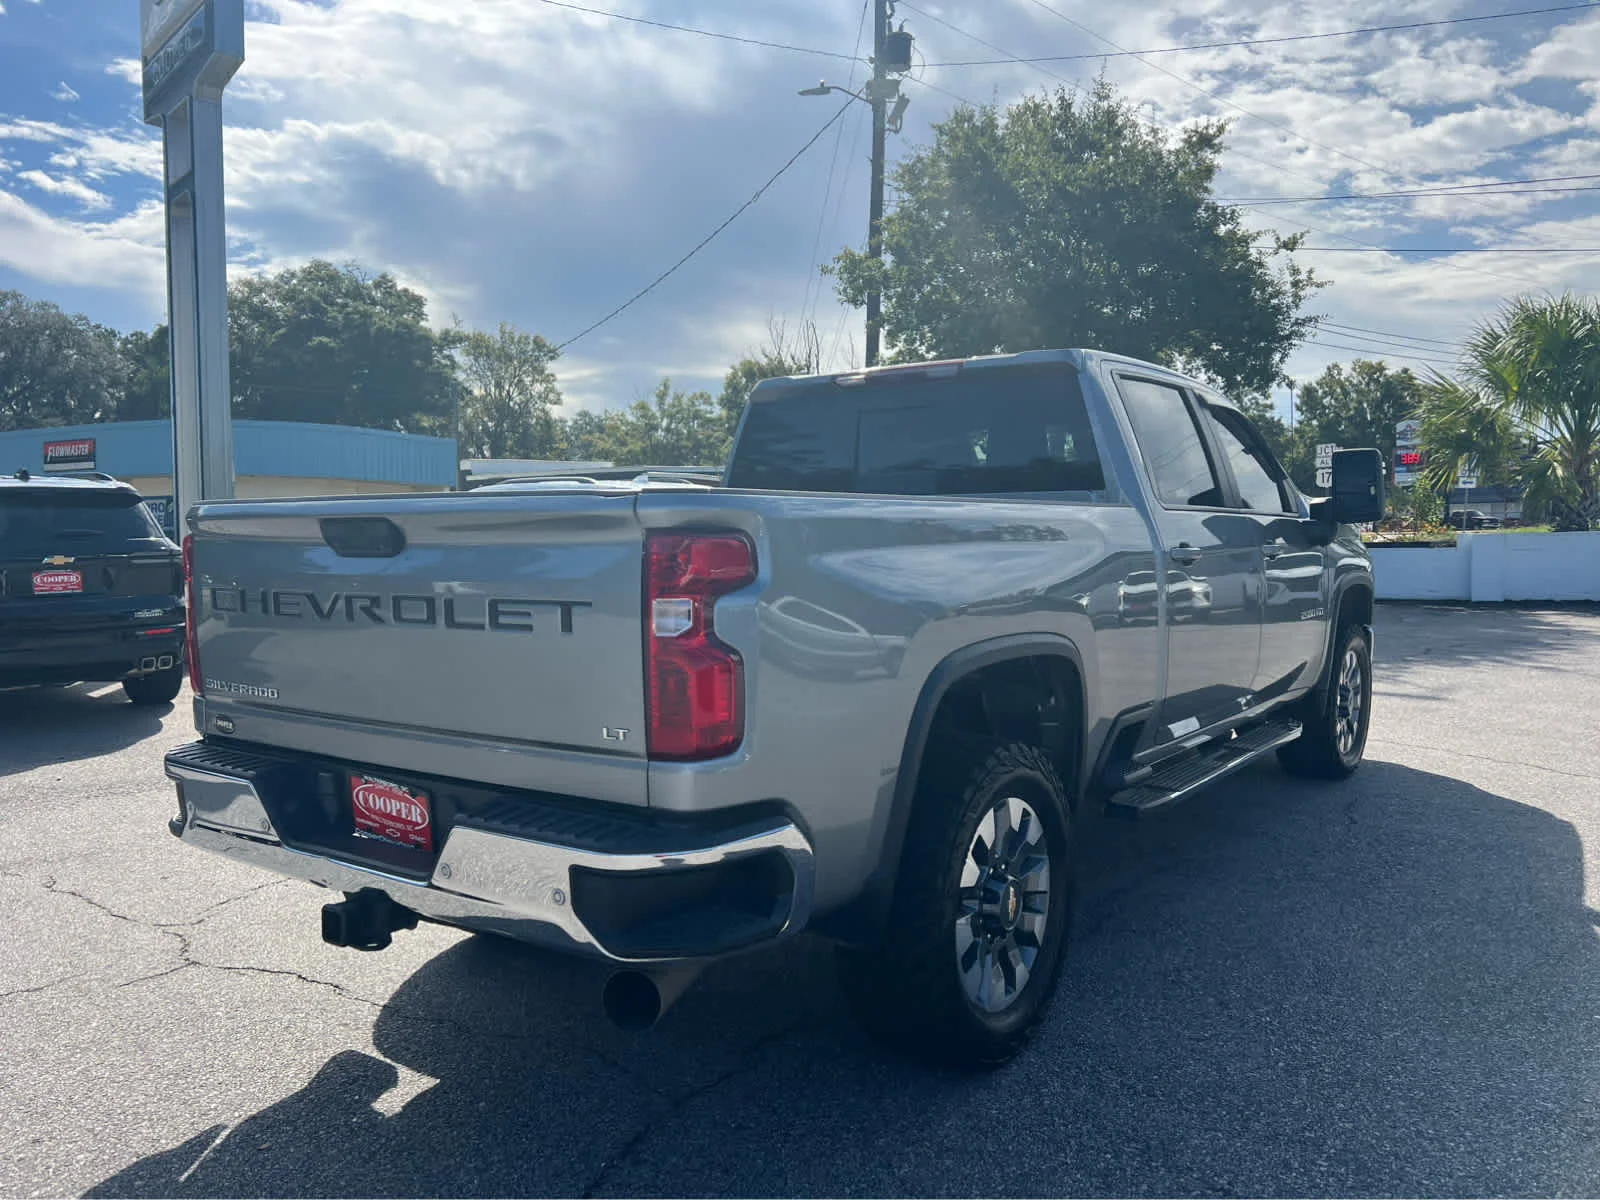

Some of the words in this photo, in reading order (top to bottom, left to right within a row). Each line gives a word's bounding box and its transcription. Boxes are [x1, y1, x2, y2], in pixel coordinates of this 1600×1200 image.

[1321, 471, 1332, 484] 17
[210, 586, 593, 633] CHEVROLET
[205, 678, 279, 699] SILVERADO
[602, 727, 630, 740] LT
[358, 790, 423, 824] COOPER
